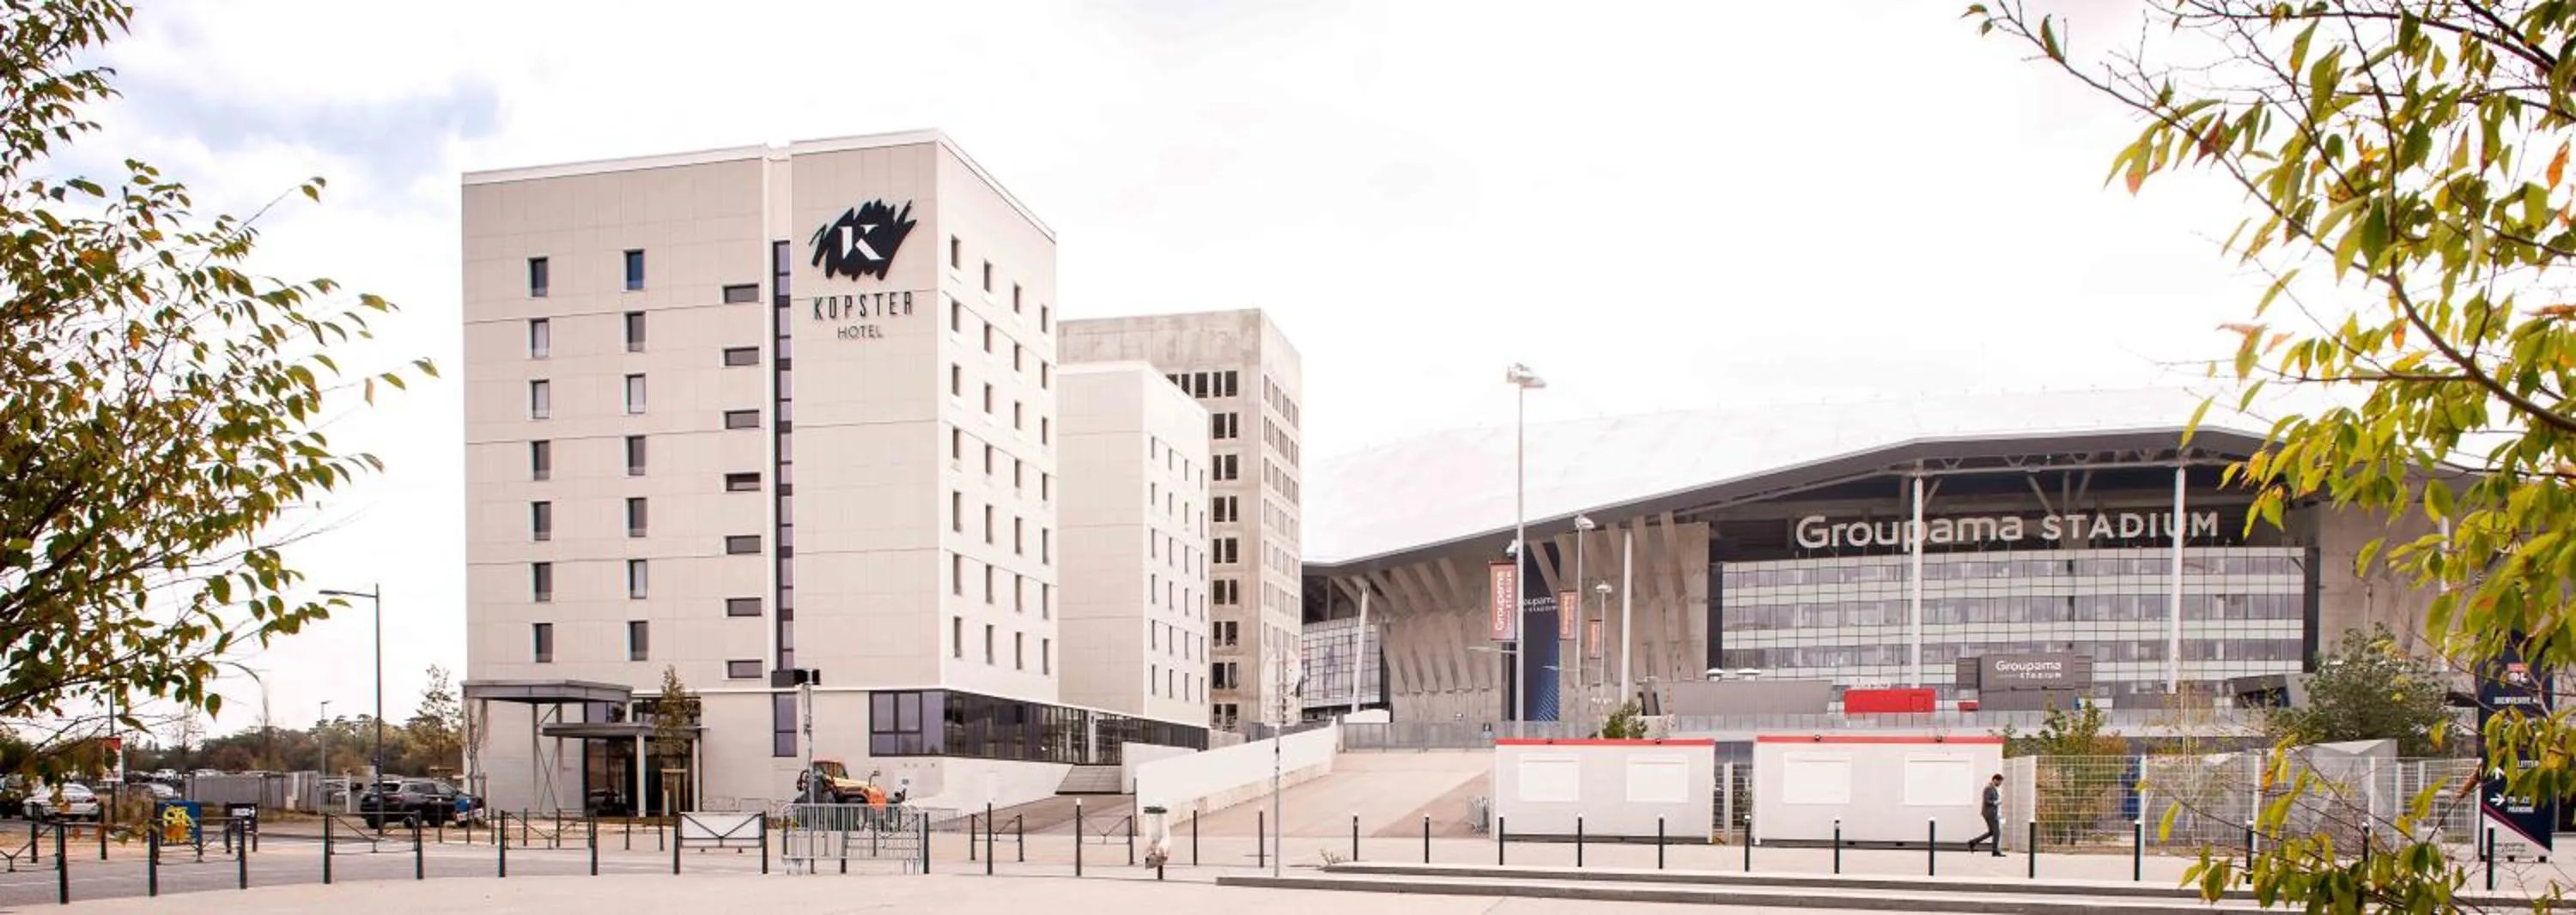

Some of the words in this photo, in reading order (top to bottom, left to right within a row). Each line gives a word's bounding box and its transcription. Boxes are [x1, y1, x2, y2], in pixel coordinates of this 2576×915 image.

[837, 224, 885, 261] K
[814, 291, 913, 320] KOPSTER
[837, 325, 884, 339] HOTEL
[1795, 515, 2023, 552] Groupama
[2041, 512, 2218, 540] STADIUM
[1996, 660, 2062, 672] Groupama
